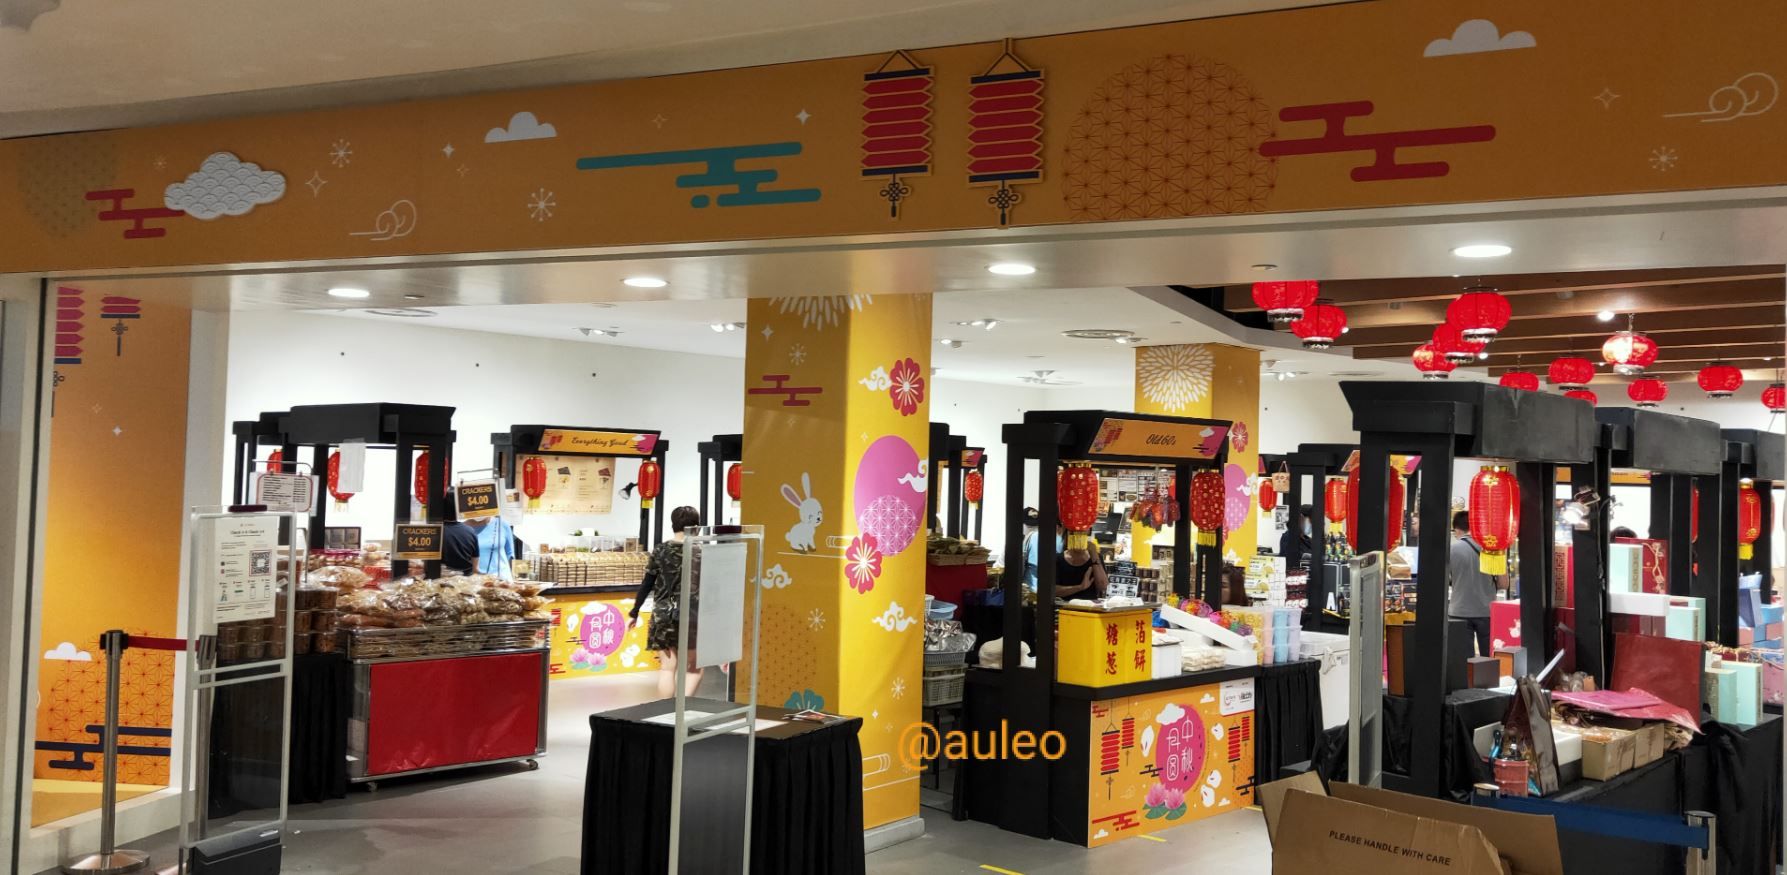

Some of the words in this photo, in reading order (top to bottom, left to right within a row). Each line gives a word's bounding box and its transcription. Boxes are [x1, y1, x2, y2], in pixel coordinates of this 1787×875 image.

[571, 437, 608, 447] Everything
[610, 439, 629, 447] Good
[462, 486, 493, 495] CRACKERS
[467, 495, 489, 507] $4.00
[402, 527, 438, 535] CRACKERS
[408, 536, 432, 547] $4.00
[1329, 830, 1362, 845] PLEASE
[1364, 838, 1399, 854] HANDLE
[1401, 847, 1424, 860] WITH
[1426, 854, 1451, 866] CARE
